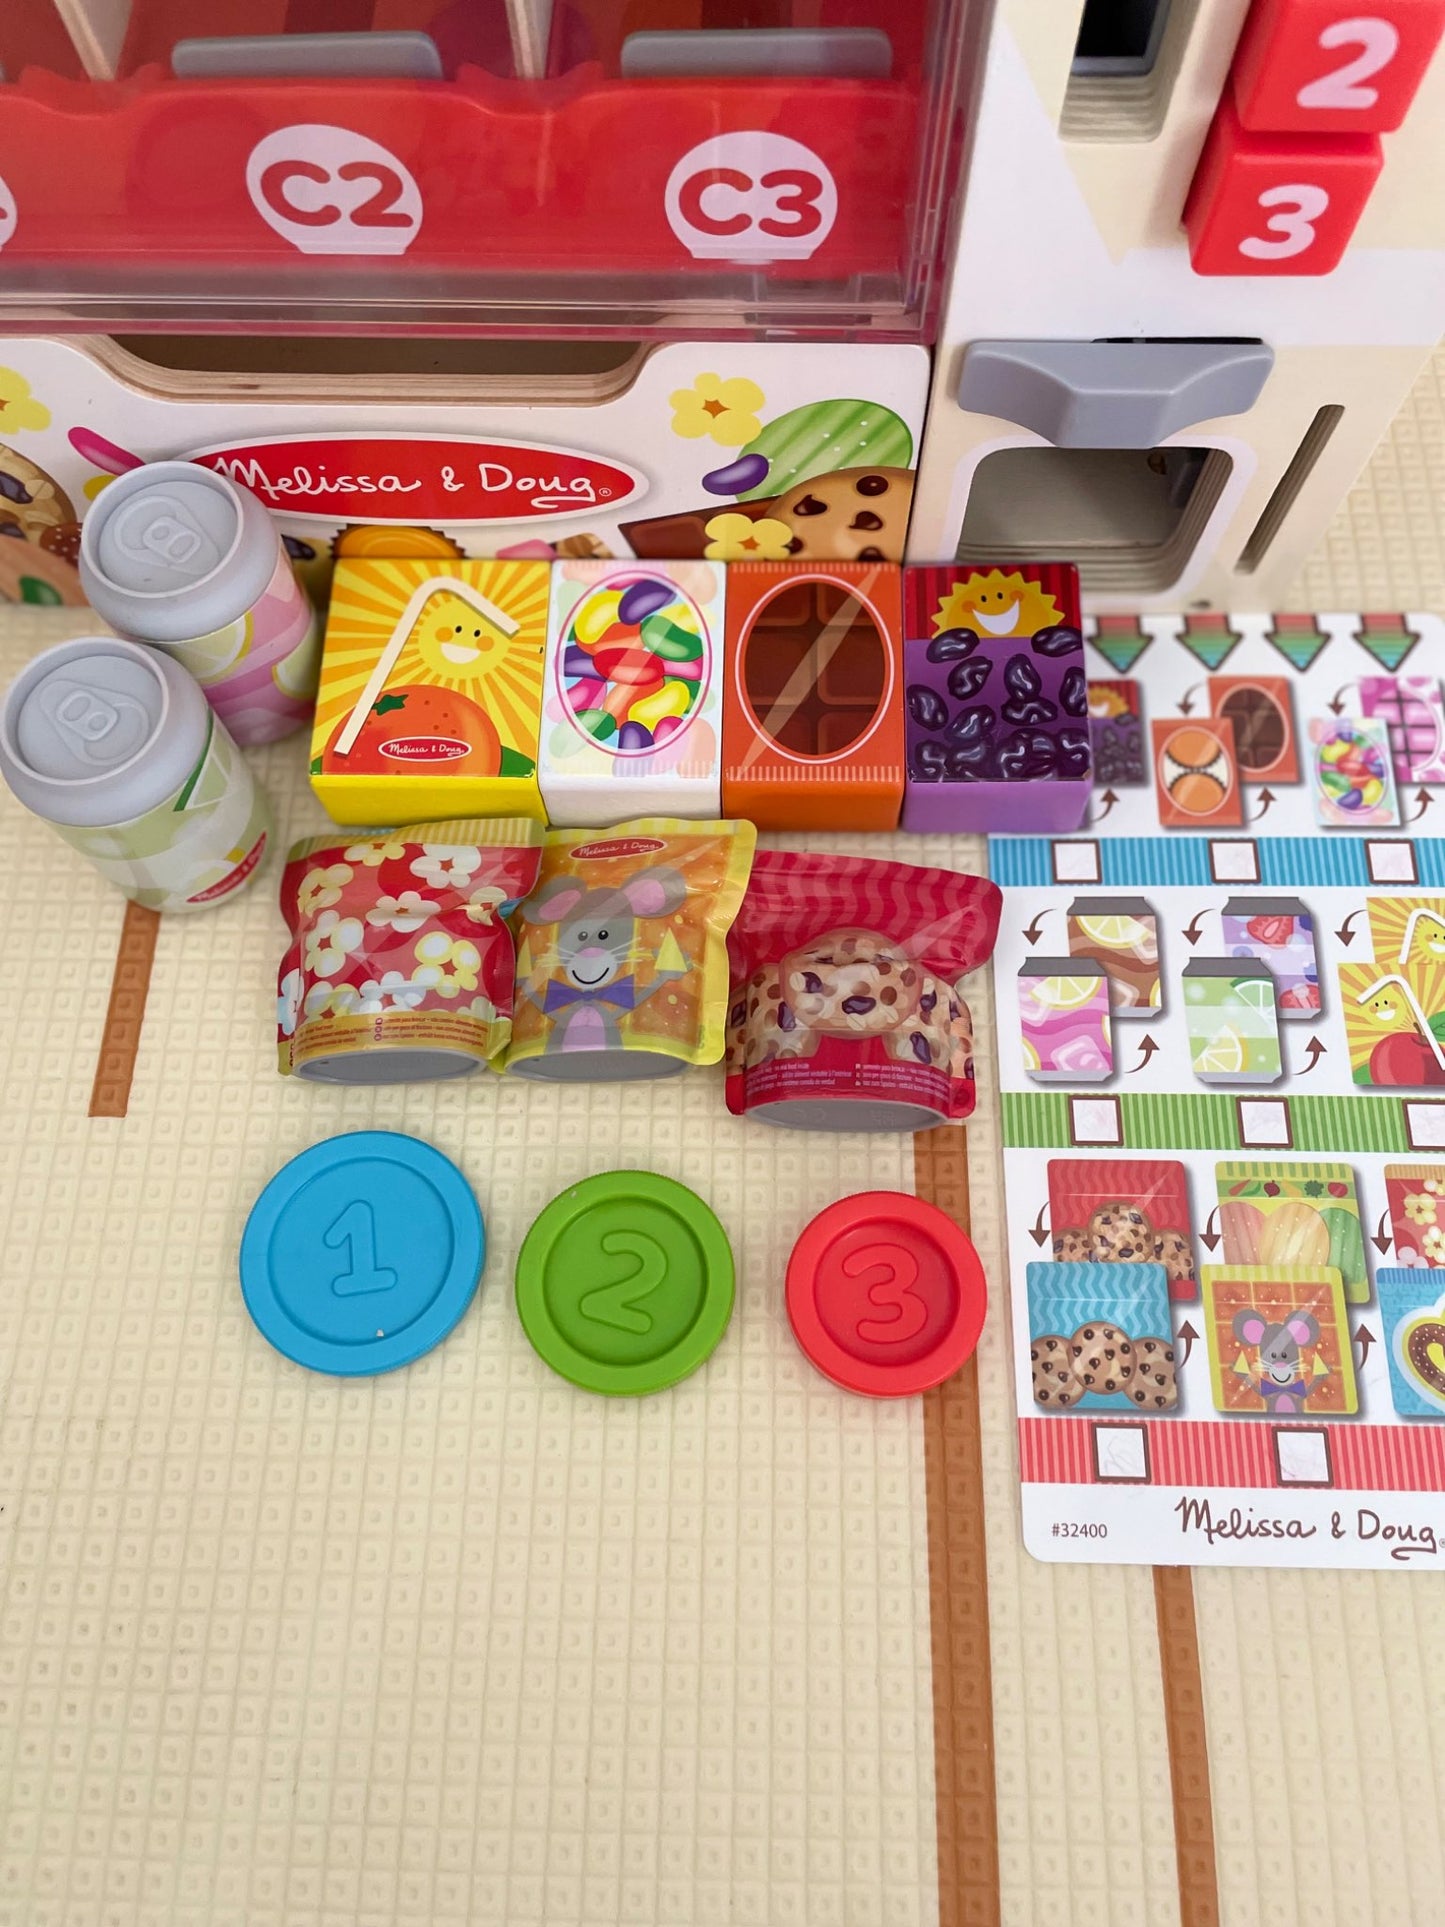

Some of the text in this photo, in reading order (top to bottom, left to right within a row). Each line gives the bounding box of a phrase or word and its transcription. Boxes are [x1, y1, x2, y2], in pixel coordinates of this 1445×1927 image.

[1297, 16, 1399, 109] 2
[260, 160, 413, 228] C2
[678, 167, 823, 238] C3
[1238, 184, 1329, 260] 3
[213, 457, 422, 500] Melissa
[441, 466, 464, 492] &
[388, 743, 428, 756] Melissa
[322, 1199, 399, 1298] 1
[578, 1229, 669, 1336] 2
[841, 1243, 930, 1346] 3
[1052, 1522, 1108, 1539] #32400
[1174, 1496, 1317, 1545] Melissa
[1330, 1511, 1347, 1539] &
